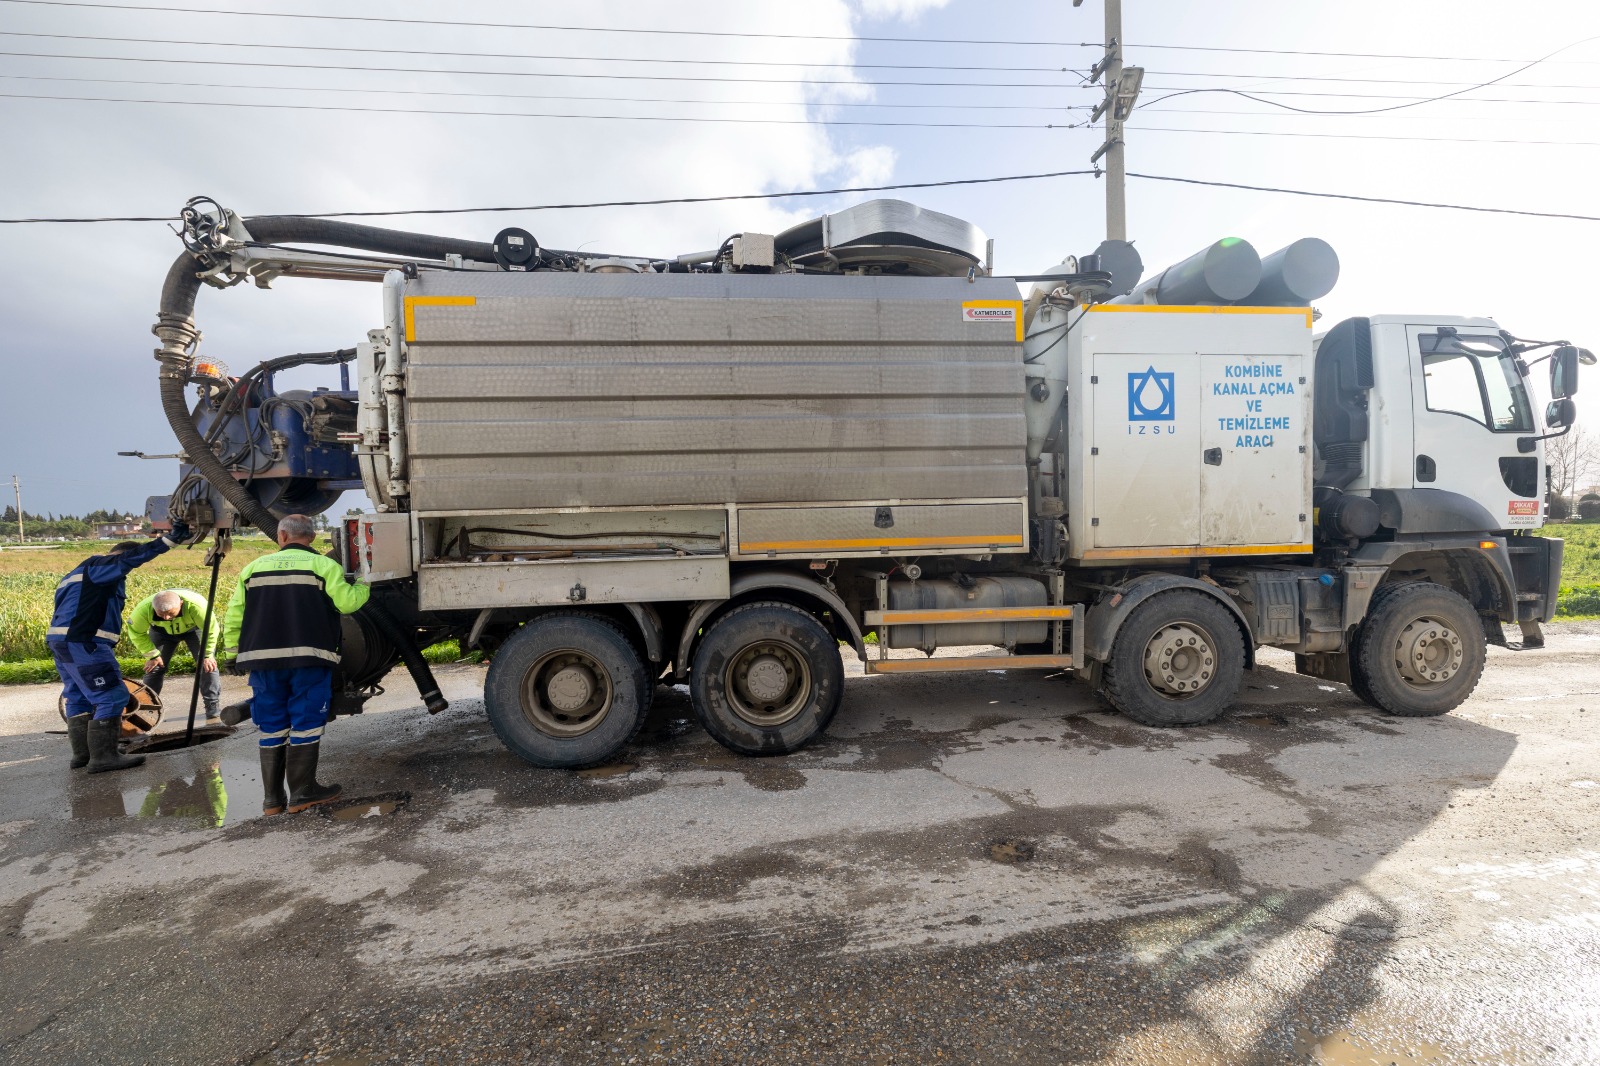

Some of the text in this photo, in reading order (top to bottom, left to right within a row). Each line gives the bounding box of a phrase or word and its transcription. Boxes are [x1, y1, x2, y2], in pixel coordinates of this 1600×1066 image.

[1225, 361, 1283, 378] KOMBİNE
[1213, 382, 1295, 397] KANAL AÇMA
[1246, 400, 1263, 413] VE
[1128, 424, 1176, 435] İZSU
[1218, 415, 1290, 431] TEMİZLEME
[1236, 435, 1274, 448] ARACI
